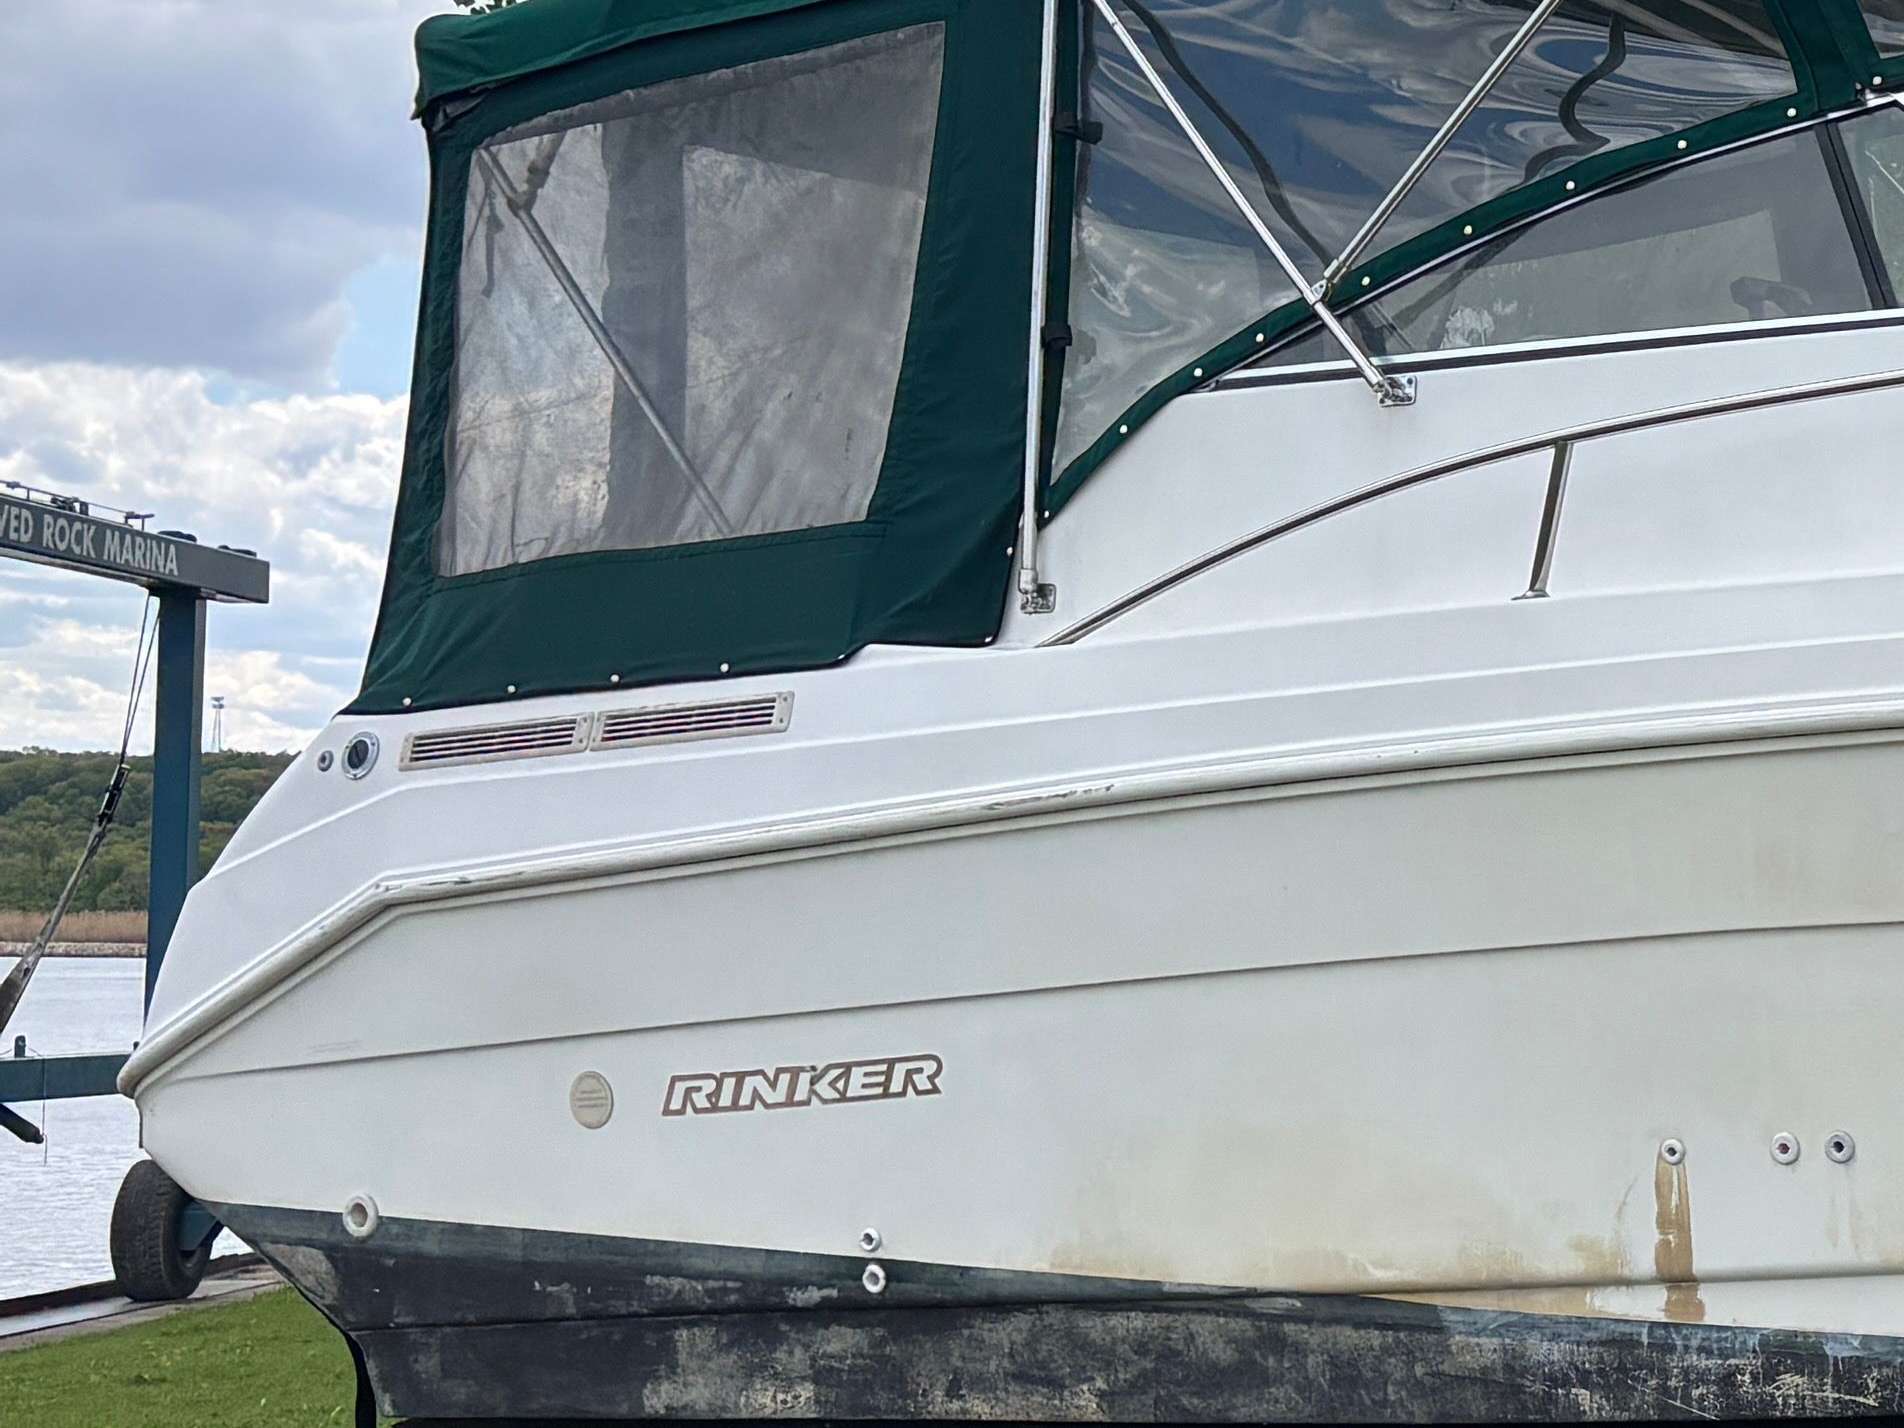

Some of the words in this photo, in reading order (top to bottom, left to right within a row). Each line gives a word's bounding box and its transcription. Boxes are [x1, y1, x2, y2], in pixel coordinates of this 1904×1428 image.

[42, 514, 97, 559] ROCK
[103, 528, 179, 577] MARINA
[661, 1053, 944, 1117] RINKER
